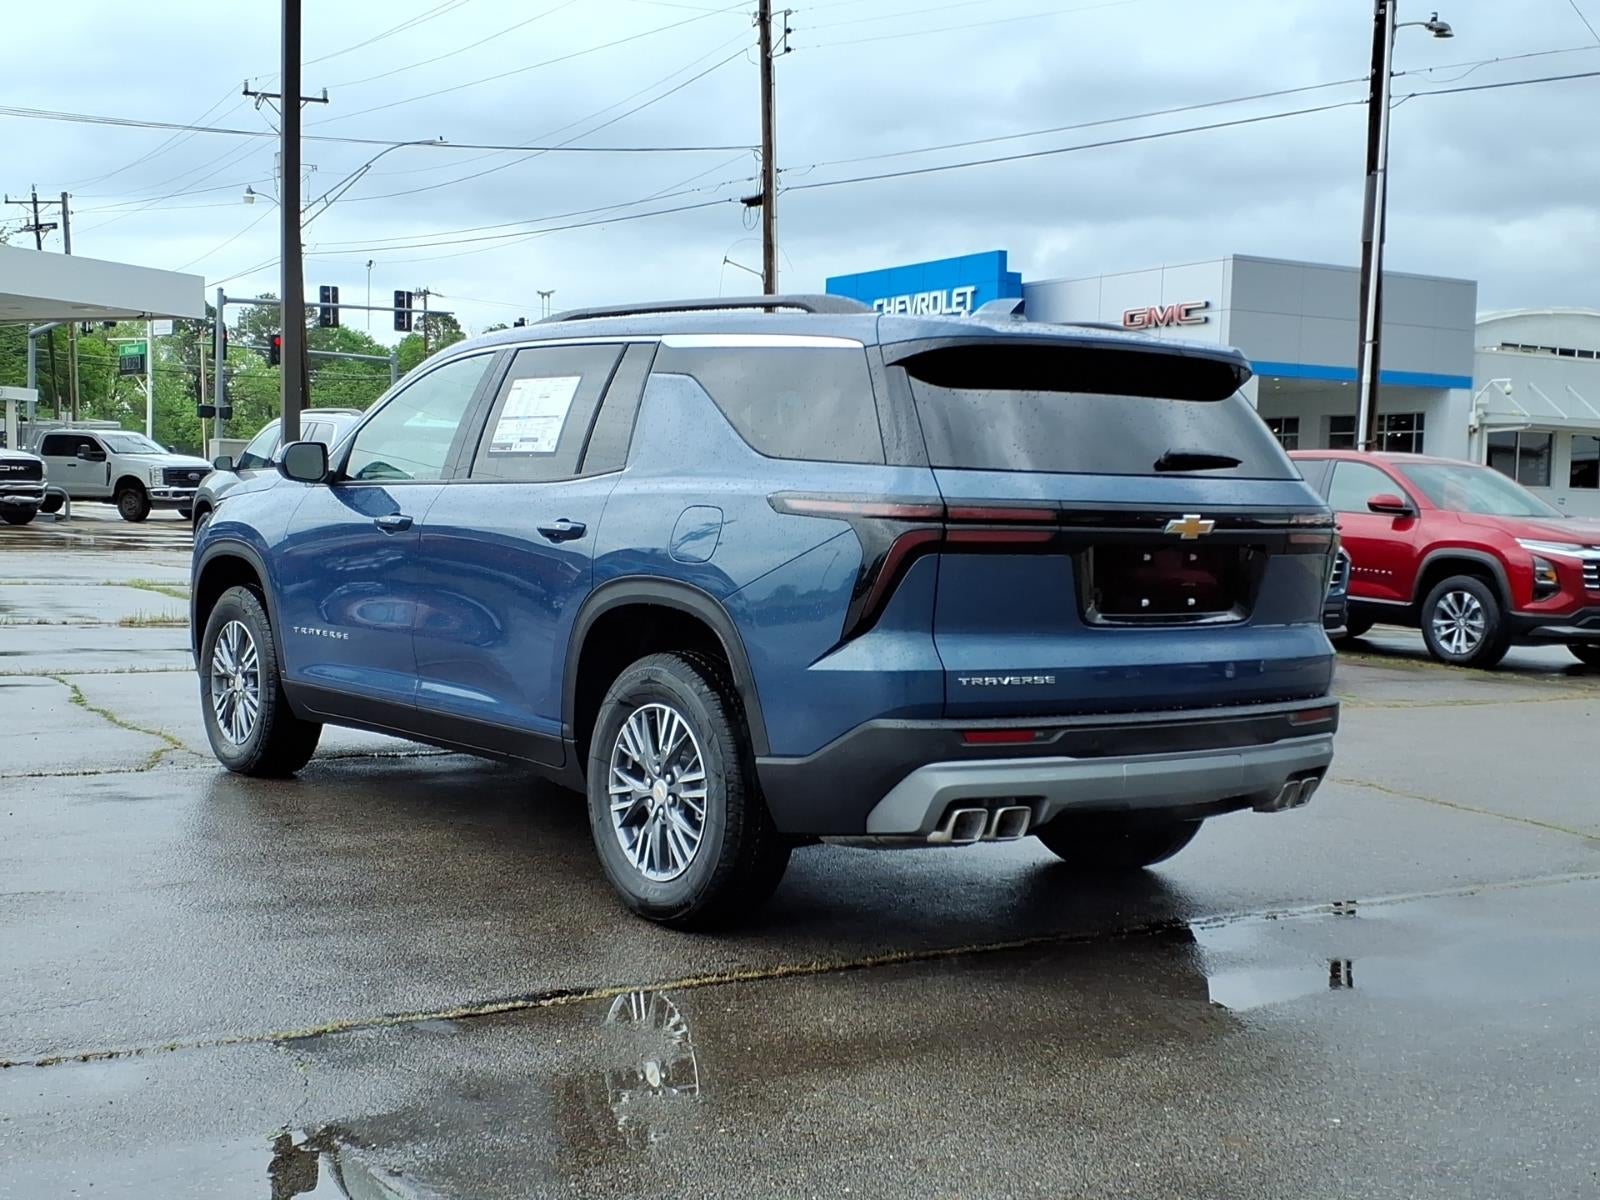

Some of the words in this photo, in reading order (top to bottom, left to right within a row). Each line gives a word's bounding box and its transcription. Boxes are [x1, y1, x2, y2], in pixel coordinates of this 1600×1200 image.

[1123, 301, 1207, 328] GMC
[293, 626, 349, 640] TRAVERSE
[958, 676, 1056, 686] TRAVERSE
